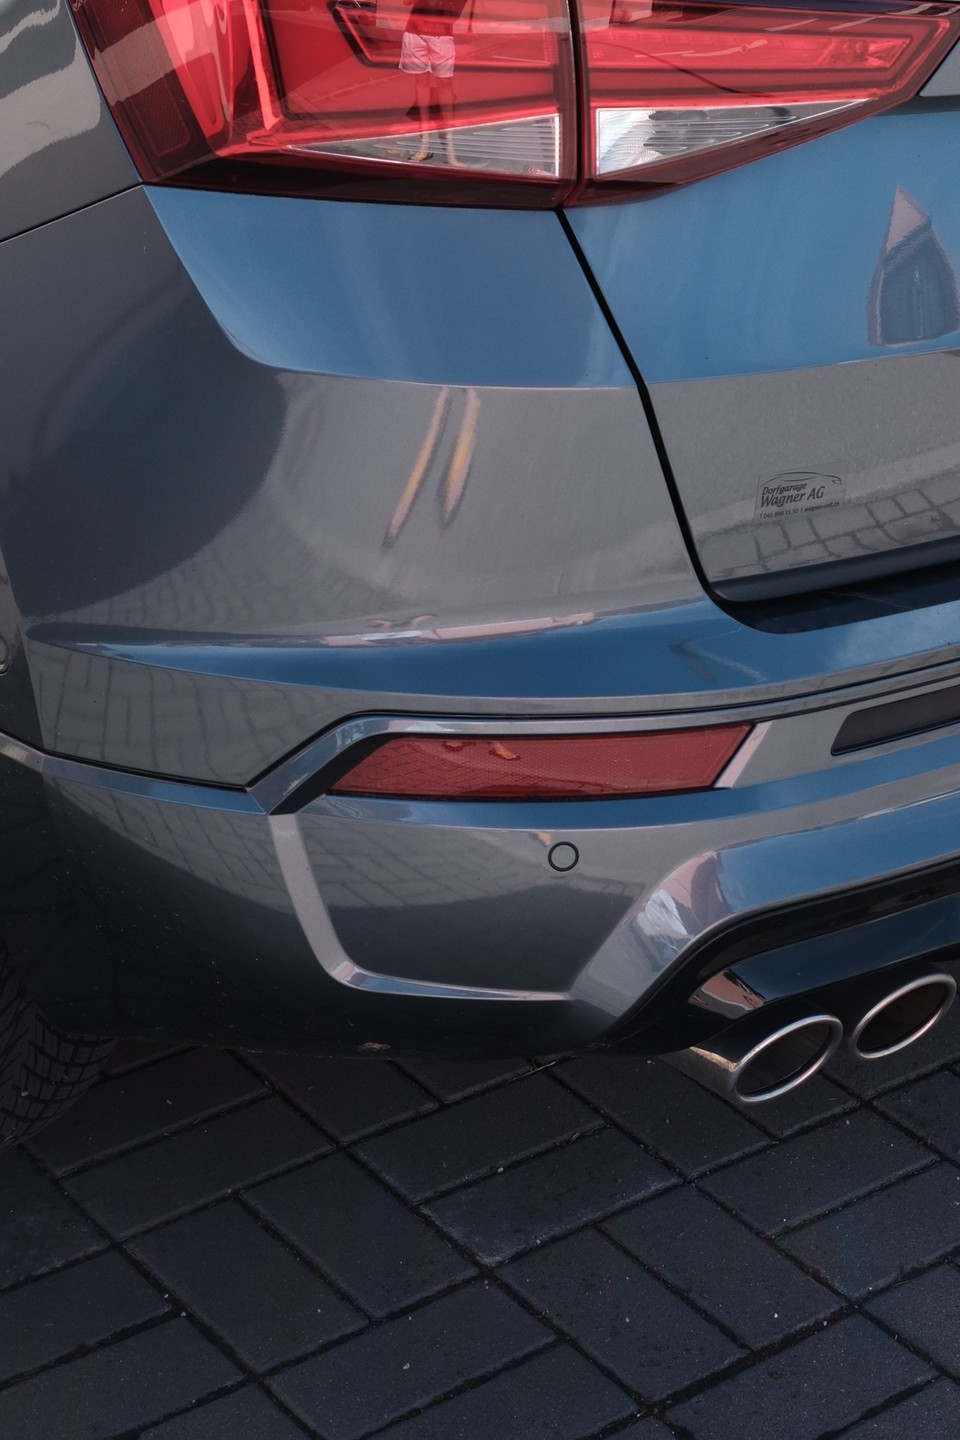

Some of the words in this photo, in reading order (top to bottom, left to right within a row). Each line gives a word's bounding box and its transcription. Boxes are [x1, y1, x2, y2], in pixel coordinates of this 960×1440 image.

[760, 492, 806, 508] Wagner
[807, 485, 825, 500] AG
[762, 483, 807, 495] Dorfgarage
